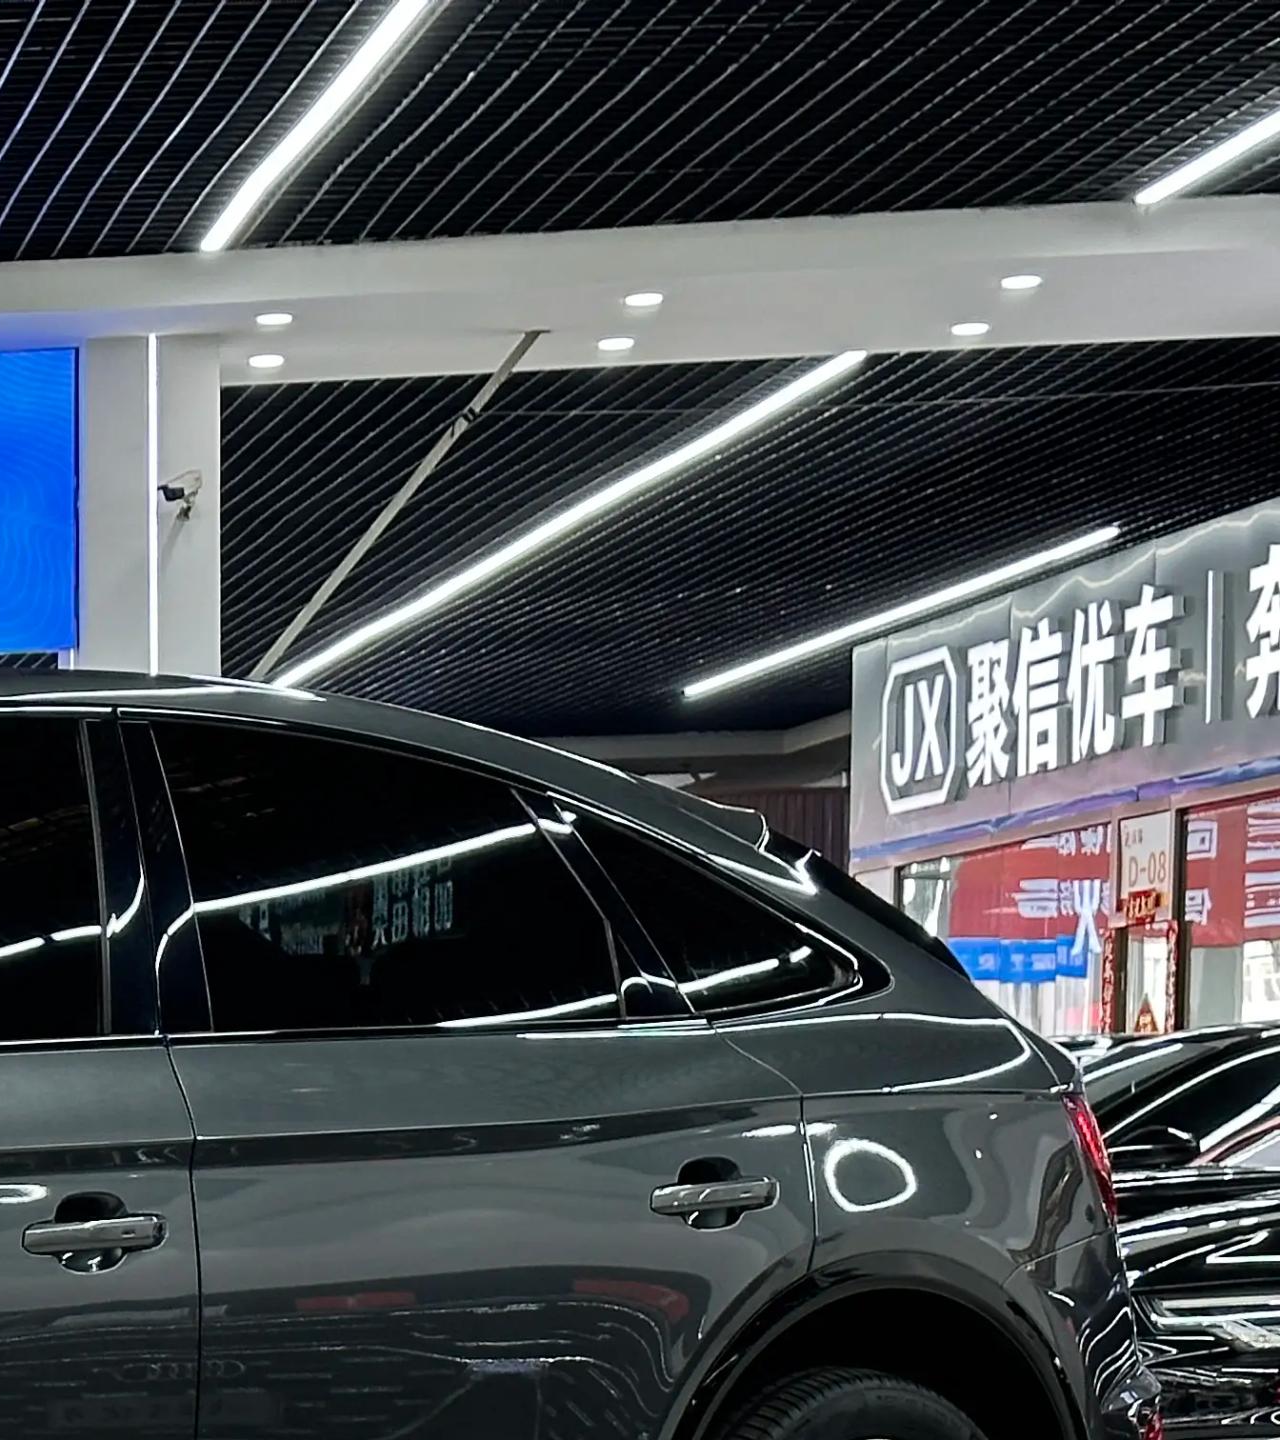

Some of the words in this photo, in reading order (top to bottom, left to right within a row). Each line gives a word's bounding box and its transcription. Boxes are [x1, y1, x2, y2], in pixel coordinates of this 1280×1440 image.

[889, 673, 945, 787] JX
[964, 584, 1176, 788] 聚信优车
[1128, 850, 1167, 888] D-08
